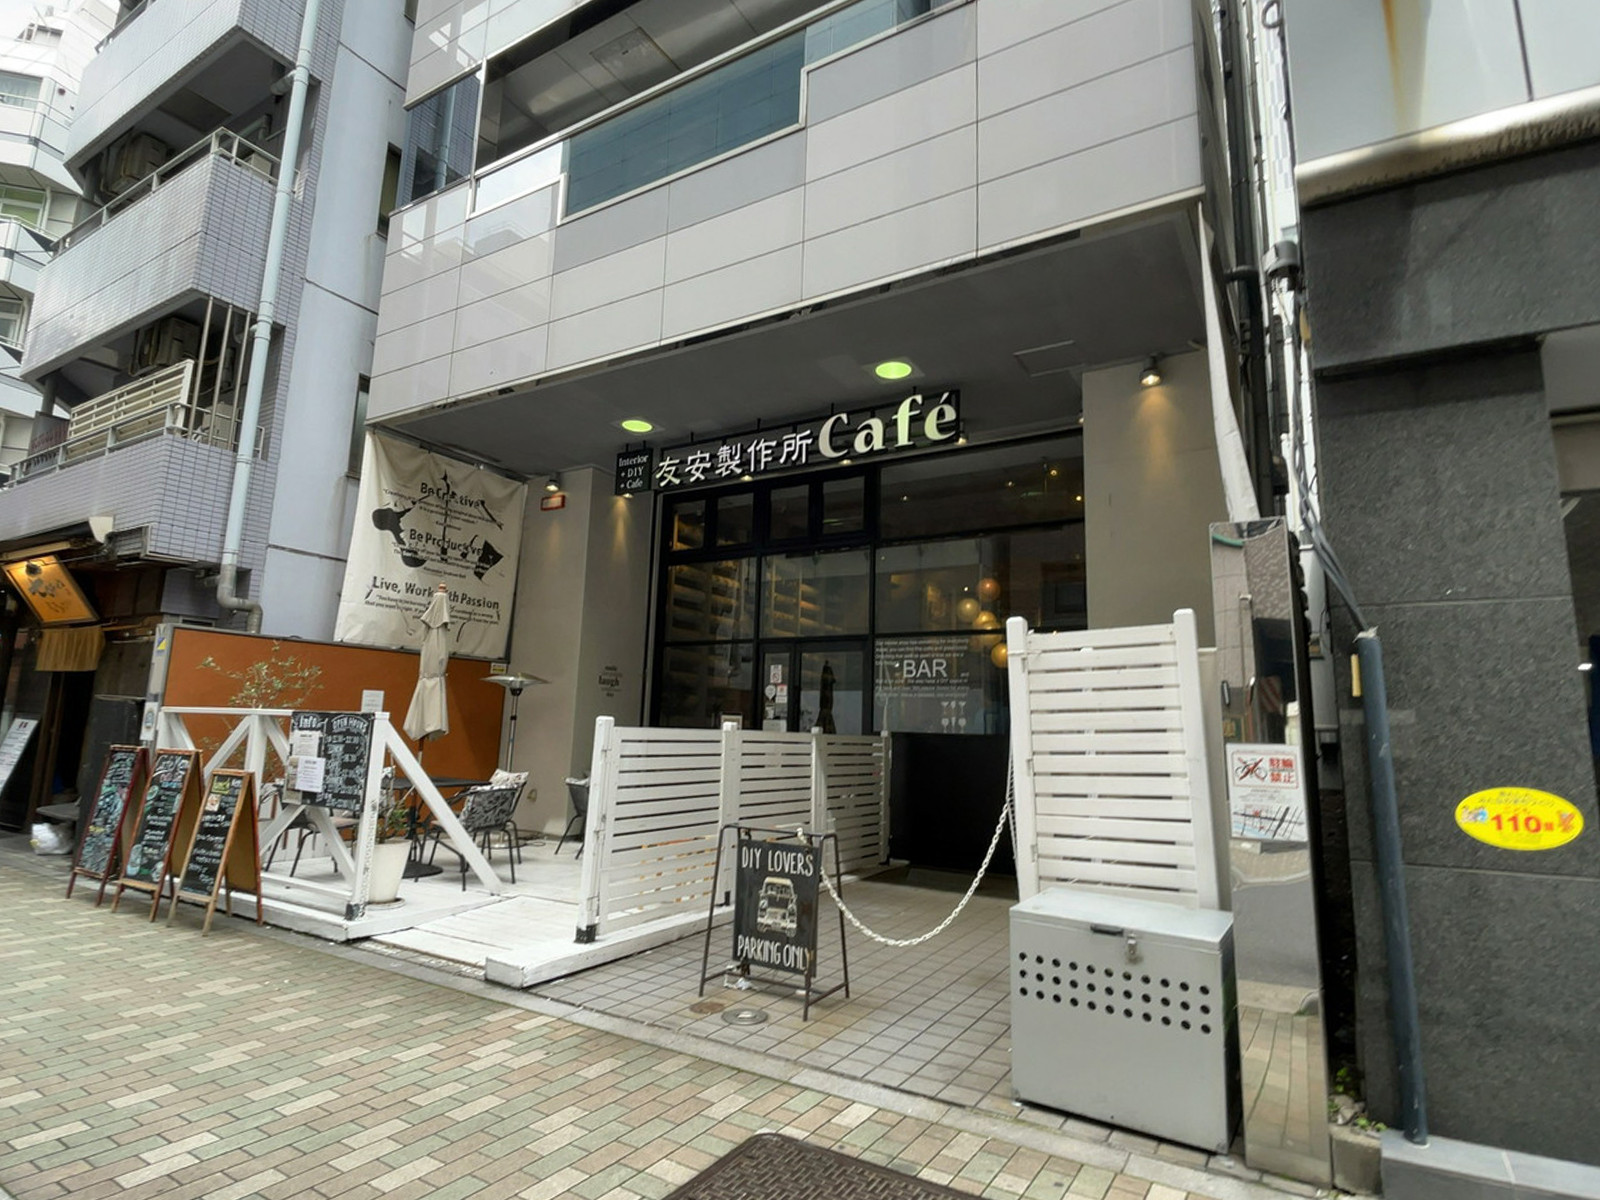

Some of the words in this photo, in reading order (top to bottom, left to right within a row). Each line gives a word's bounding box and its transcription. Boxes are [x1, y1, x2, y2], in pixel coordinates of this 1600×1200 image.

[655, 429, 814, 487] 友安製作所
[818, 391, 957, 459] Café
[618, 455, 649, 467] Interior
[627, 466, 644, 478] DIY
[409, 528, 424, 543] Be
[372, 576, 401, 595] Live,
[404, 582, 434, 598] Work
[460, 593, 499, 610] Passion
[903, 659, 947, 678] BAR
[741, 846, 762, 870] DIY
[767, 849, 814, 877] LOVERS
[737, 934, 781, 966] PARKING
[783, 944, 810, 976] ONLY
